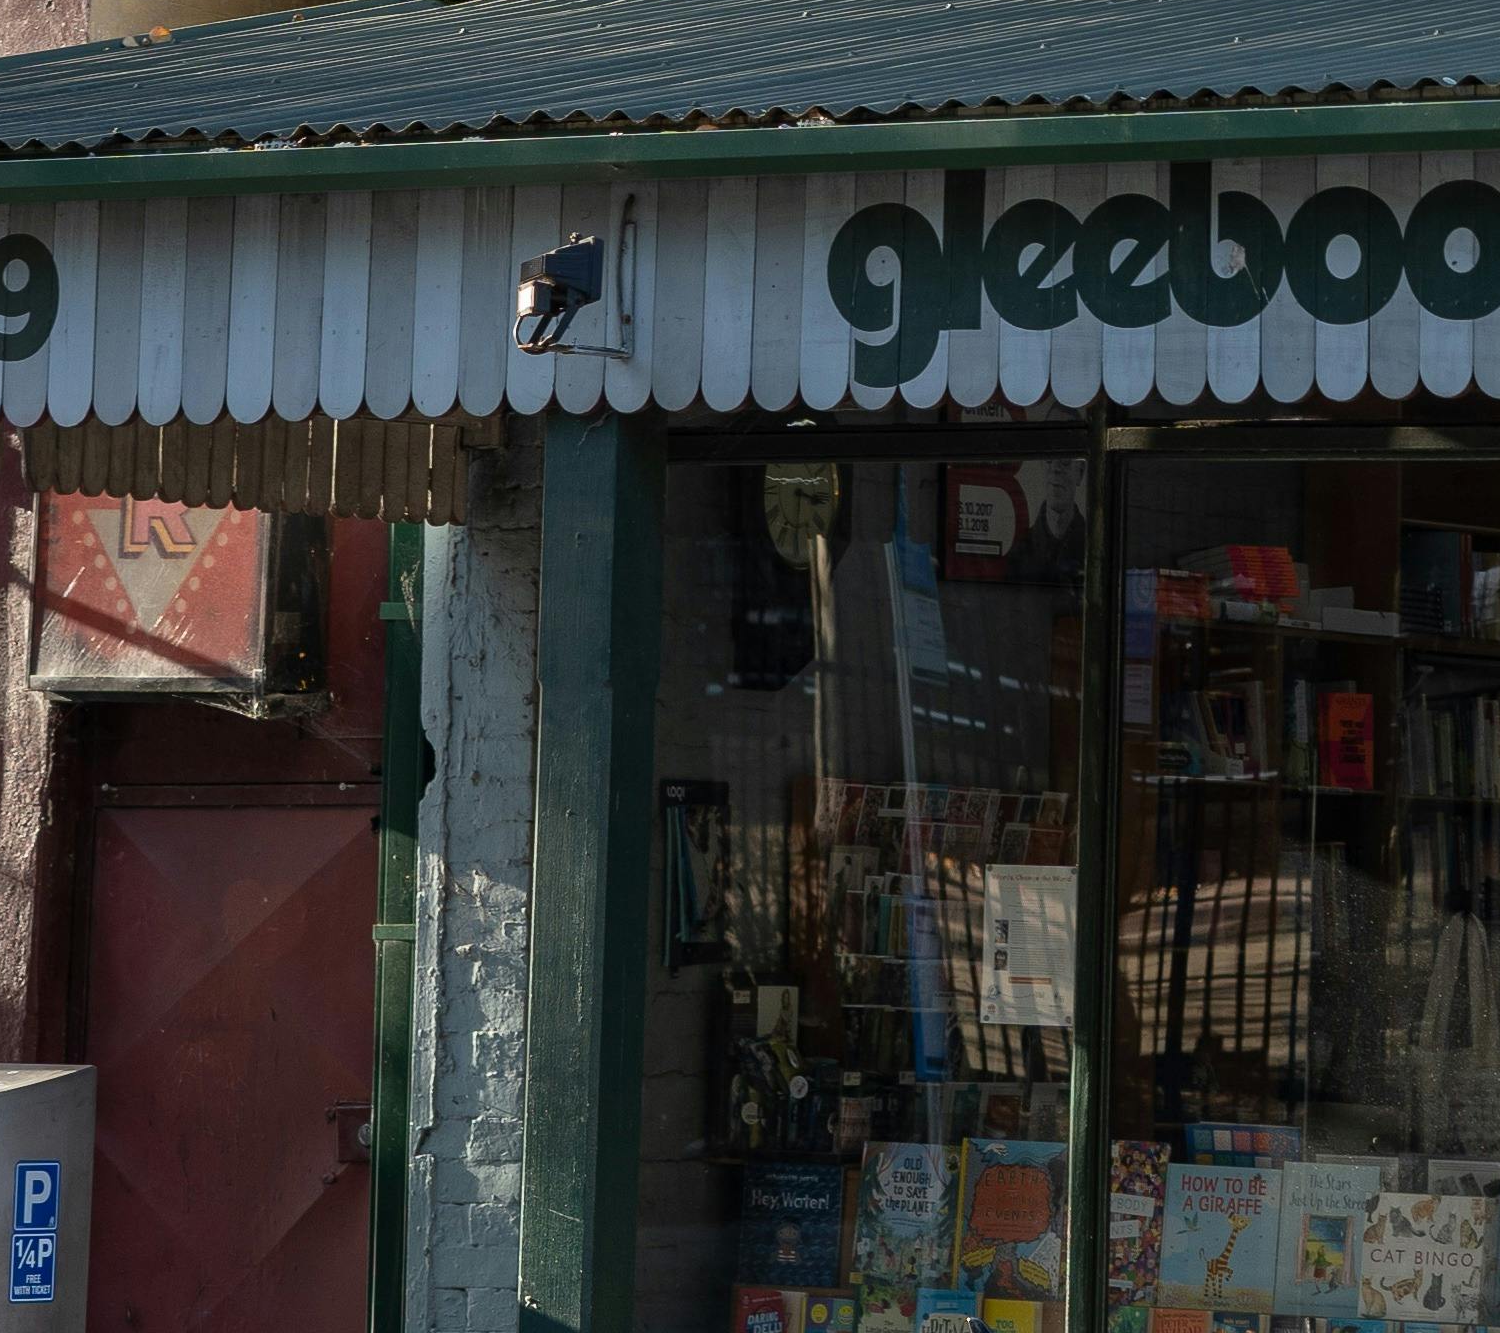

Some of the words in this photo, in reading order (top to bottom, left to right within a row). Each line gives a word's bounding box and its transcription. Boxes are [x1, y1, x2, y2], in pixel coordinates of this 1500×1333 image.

[903, 1156, 922, 1170] OLD
[892, 1171, 932, 1185] ENOUGH
[1181, 1174, 1219, 1193] HOW
[1223, 1177, 1244, 1194] TO
[1248, 1177, 1267, 1196] BE
[1308, 1174, 1324, 1189] The
[23, 1170, 52, 1224] P
[751, 1188, 777, 1211] Hey,
[781, 1191, 830, 1211] Water!
[893, 1185, 903, 1198] to
[906, 1185, 928, 1200] SAVE
[885, 1198, 901, 1211] the
[901, 1199, 936, 1215] PLANET
[1182, 1195, 1194, 1212] A
[1325, 1193, 1340, 1208] the
[1370, 1248, 1405, 1264] CAT
[1414, 1251, 1474, 1268] BINGO
[25, 1274, 42, 1284] FREE
[13, 1285, 31, 1296] WITH
[31, 1284, 51, 1296] TICKET
[747, 1311, 780, 1324] DARING
